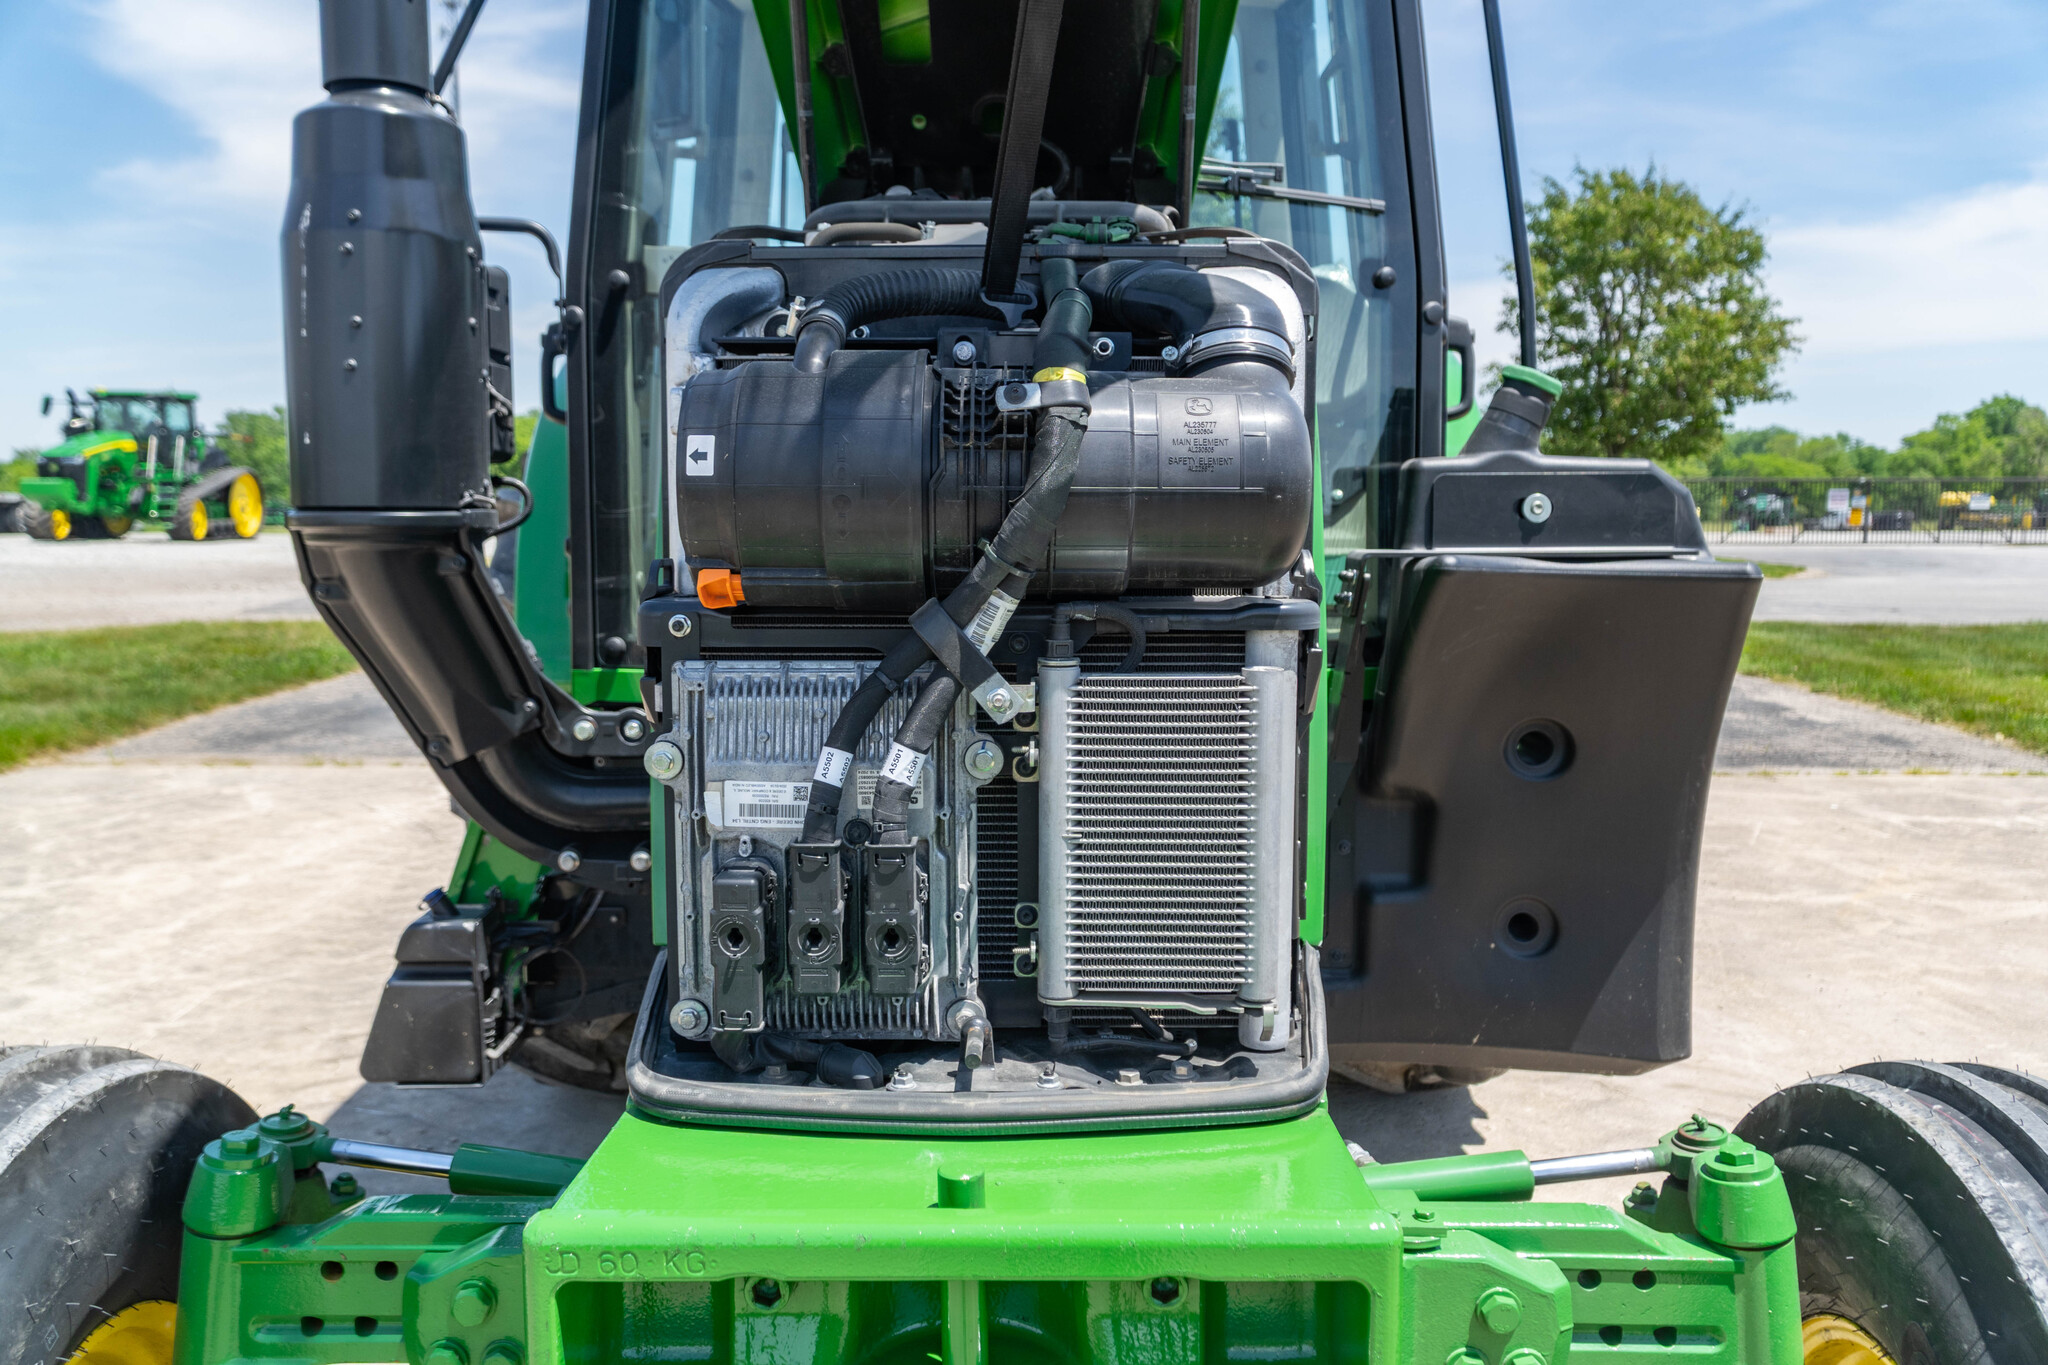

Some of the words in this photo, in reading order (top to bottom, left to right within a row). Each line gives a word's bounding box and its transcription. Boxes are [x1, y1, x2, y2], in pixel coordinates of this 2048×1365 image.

[1194, 438, 1229, 446] ELEMENT
[1168, 456, 1196, 465] SAFETY
[1199, 458, 1233, 466] ELEMENT
[822, 752, 834, 779] A5502
[839, 757, 851, 783] A5502
[889, 749, 903, 774] A5501
[906, 756, 920, 781] A5501
[545, 1252, 580, 1276] JD
[598, 1252, 638, 1276] 60
[664, 1252, 706, 1276] KG
